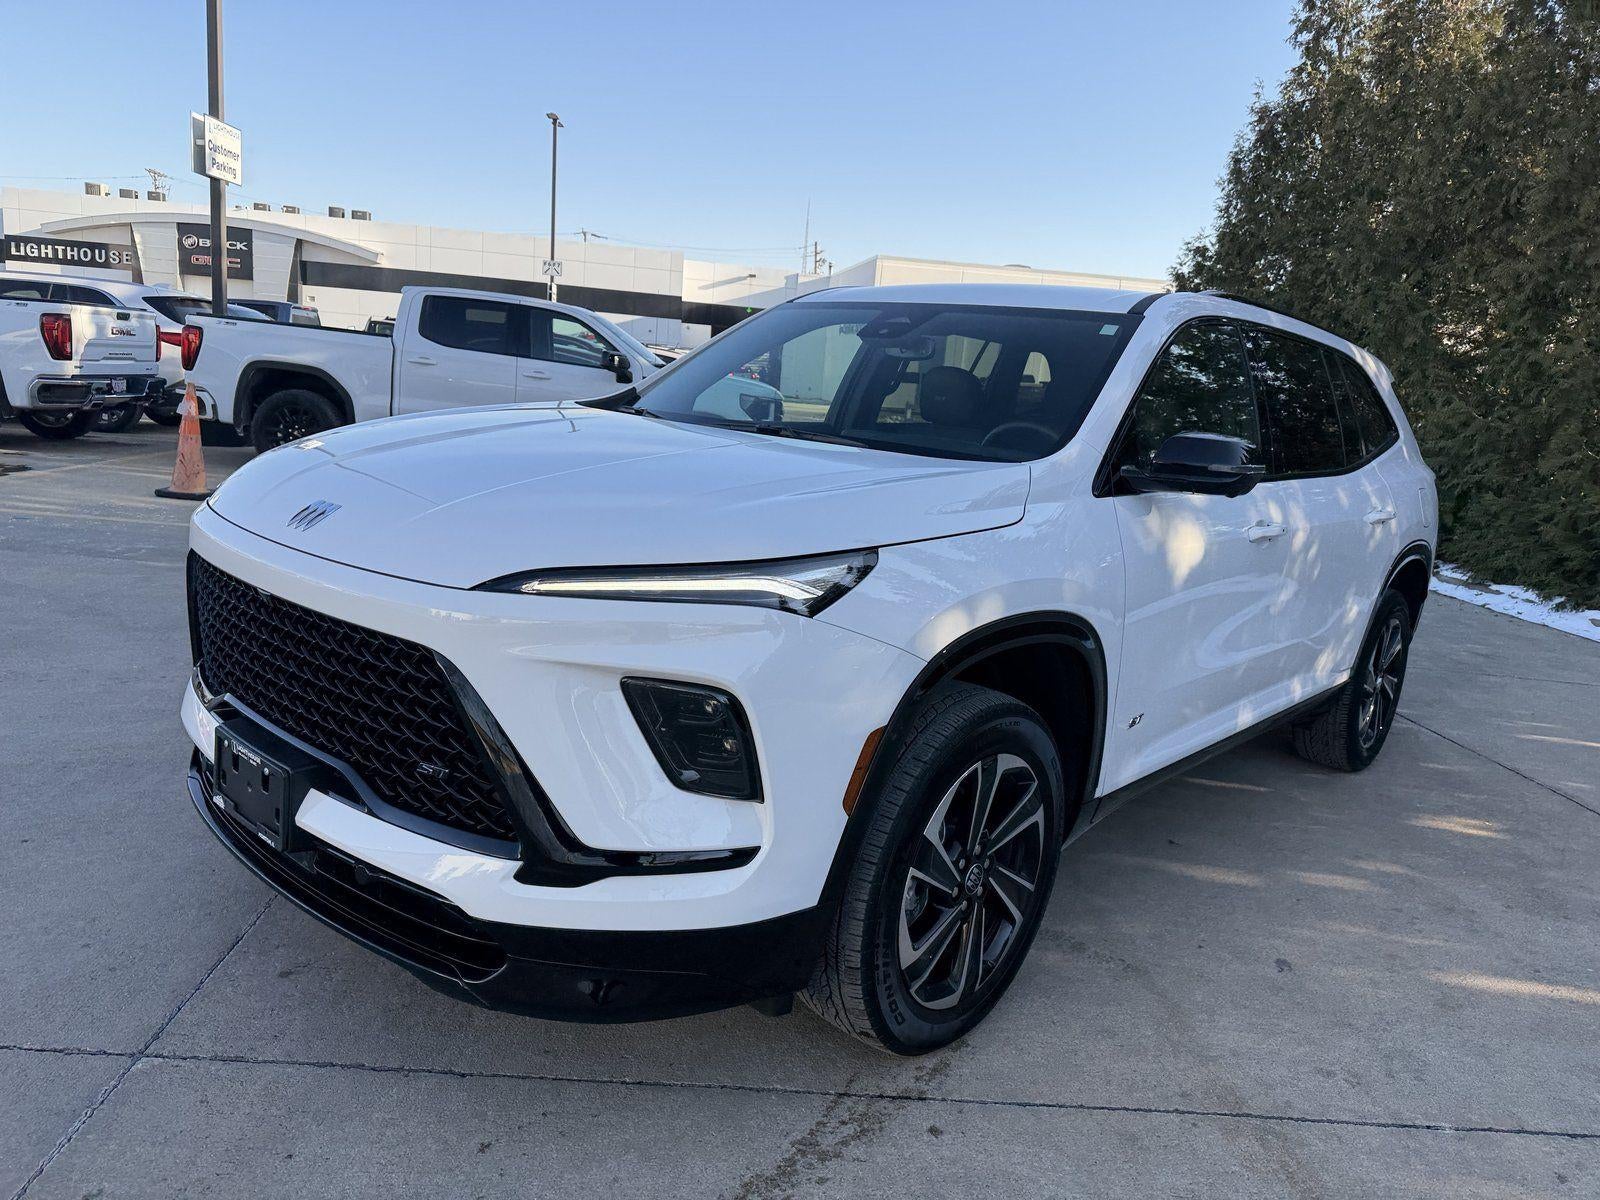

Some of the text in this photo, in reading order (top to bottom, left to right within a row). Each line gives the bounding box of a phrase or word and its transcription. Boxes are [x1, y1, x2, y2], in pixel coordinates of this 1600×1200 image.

[208, 140, 240, 161] Customer
[211, 157, 237, 179] Parking
[10, 241, 133, 266] LIGHTHOUSE
[199, 238, 248, 251] BCK
